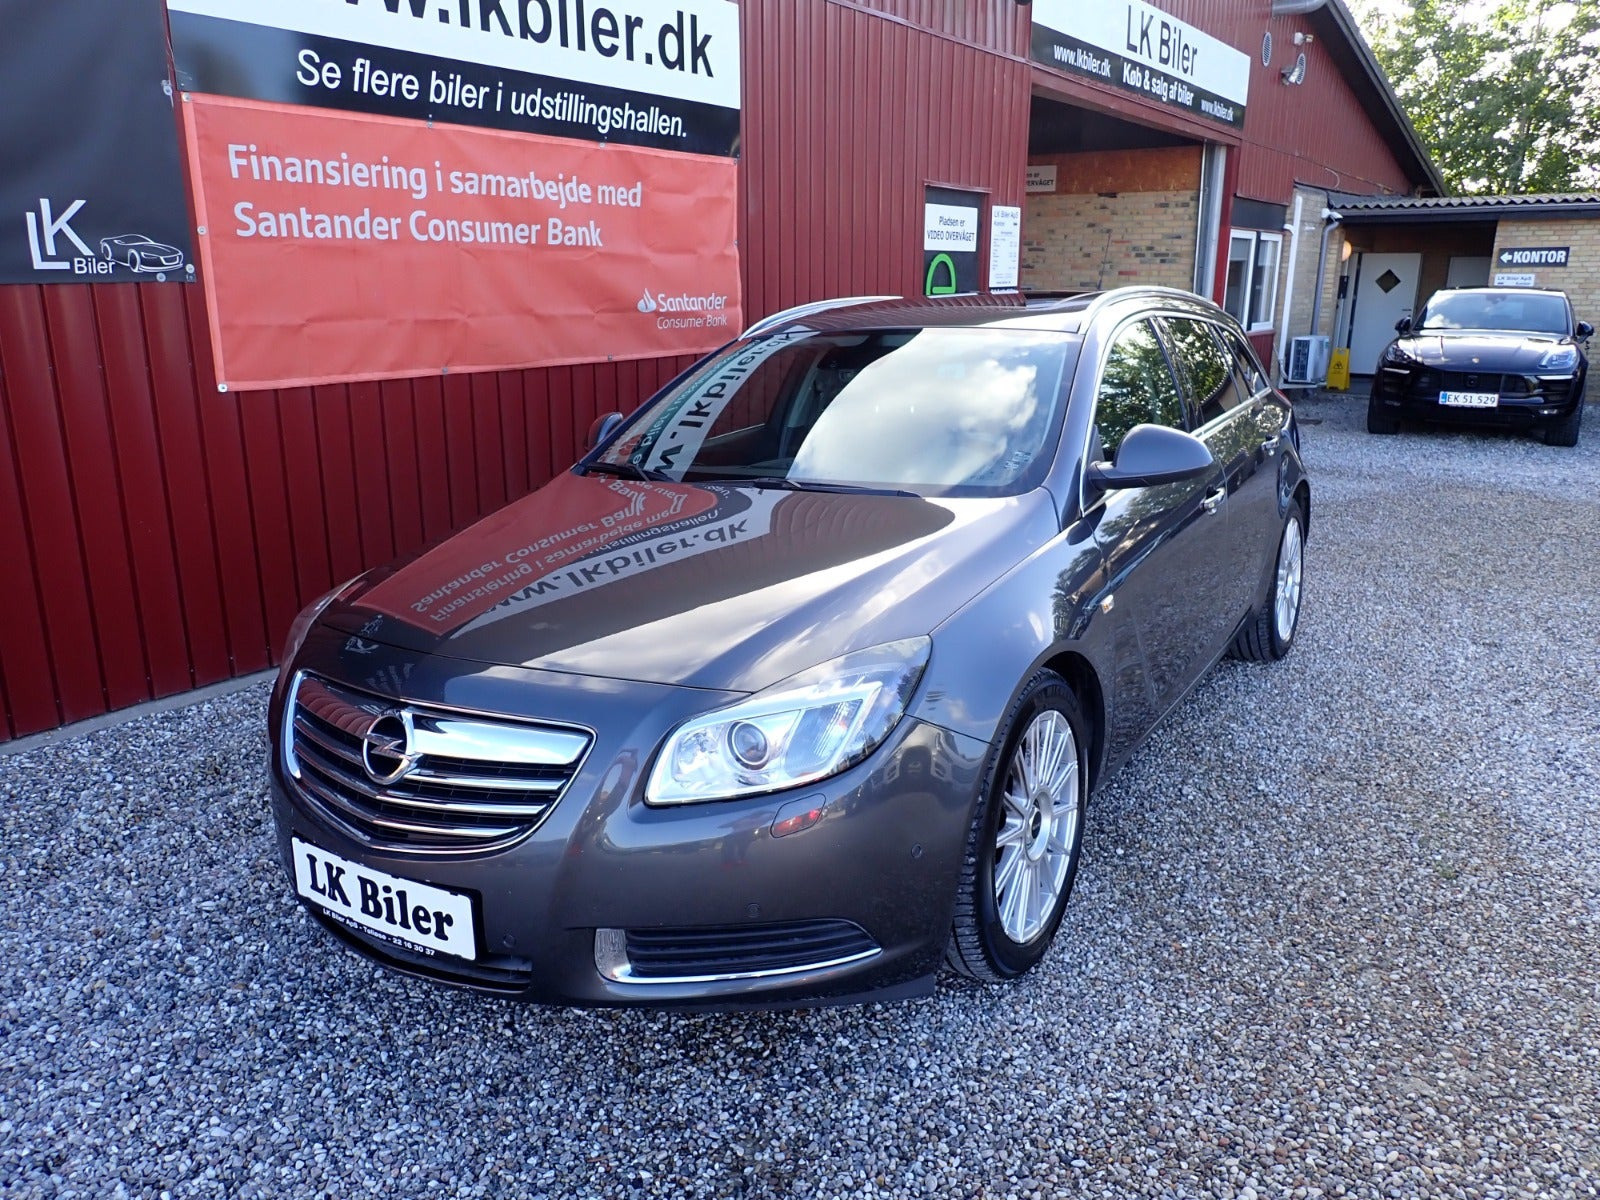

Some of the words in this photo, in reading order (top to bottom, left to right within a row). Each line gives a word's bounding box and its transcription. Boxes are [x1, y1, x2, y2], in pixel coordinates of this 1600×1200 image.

[1126, 5, 1154, 59] LK
[1159, 19, 1198, 76] Biler
[1053, 44, 1111, 78] www.lkbiler.dk
[296, 48, 341, 89] Se
[352, 58, 420, 100] flere
[429, 71, 490, 111] biler
[495, 82, 502, 112] i
[510, 88, 687, 137] udstillingshallen.
[1122, 62, 1142, 88] Køb
[1143, 69, 1150, 90] &
[1151, 76, 1168, 102] salg
[1168, 83, 1178, 101] af
[1178, 83, 1195, 106] biler
[227, 143, 427, 200] Finansiering
[435, 161, 443, 191] i
[450, 171, 592, 209] samarbejde
[597, 182, 642, 207] med
[26, 198, 94, 270] LK
[234, 202, 401, 240] Santander
[409, 210, 541, 246] Consumer
[547, 218, 603, 247] Bank
[927, 230, 944, 240] VIDEO
[939, 216, 959, 227] Pladsen
[74, 258, 116, 275] Biler
[1513, 250, 1567, 263] KONTOR
[657, 316, 704, 329] Consumer
[706, 315, 727, 327] Bank
[658, 293, 727, 312] Santander
[1448, 394, 1460, 402] EK
[1463, 395, 1473, 403] 51
[1477, 396, 1496, 404] 529
[306, 853, 351, 907] LK
[357, 875, 454, 941] Biler
[323, 908, 331, 917] LK
[332, 911, 345, 923] Biler
[392, 937, 403, 946] 22
[413, 944, 424, 953] 30
[425, 948, 435, 956] 37
